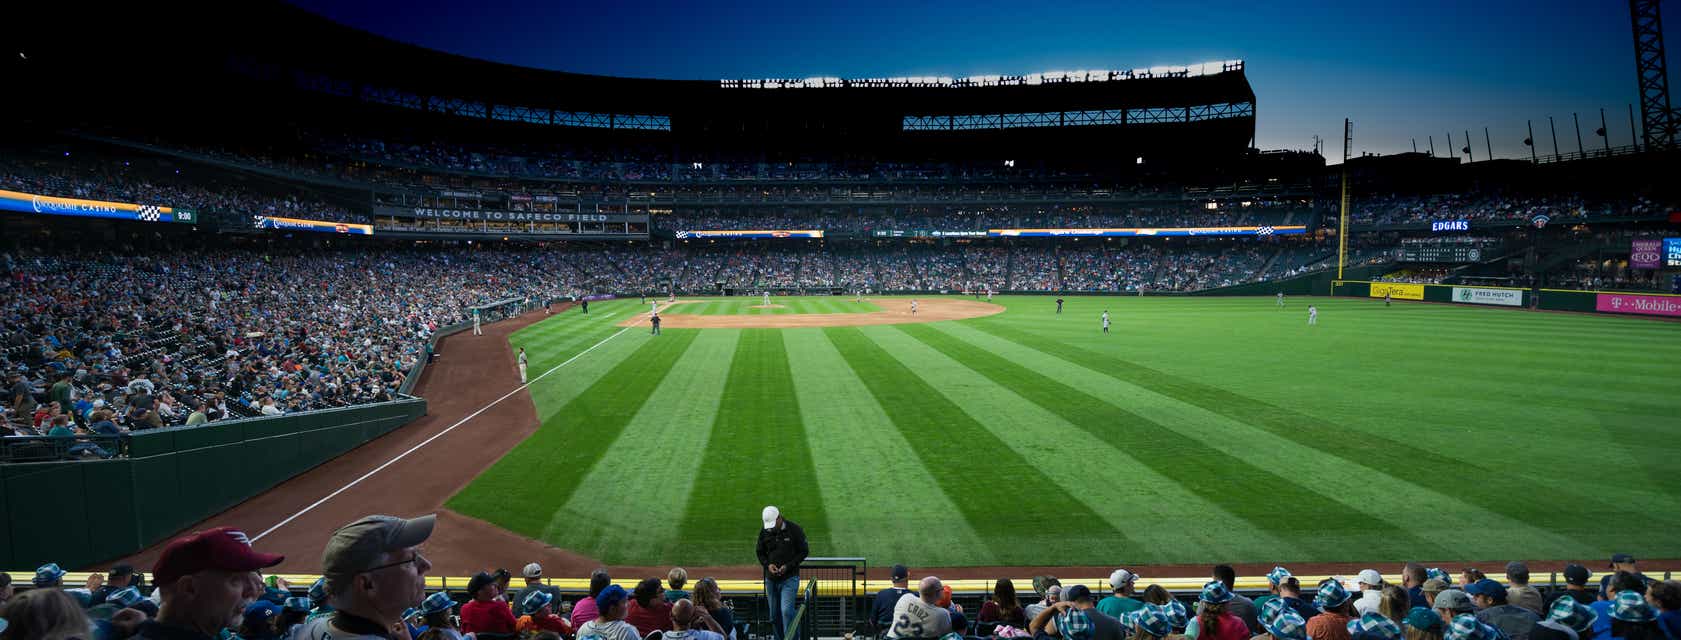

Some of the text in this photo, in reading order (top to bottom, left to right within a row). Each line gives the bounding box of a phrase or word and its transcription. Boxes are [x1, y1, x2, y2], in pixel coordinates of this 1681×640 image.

[82, 203, 117, 213] CASINO
[415, 208, 479, 218] WELCOME
[485, 211, 503, 219] TO
[509, 213, 561, 221] SAFECO
[1432, 221, 1468, 231] EDGARS
[1632, 252, 1660, 263] EQC
[907, 602, 929, 622] CRUZ
